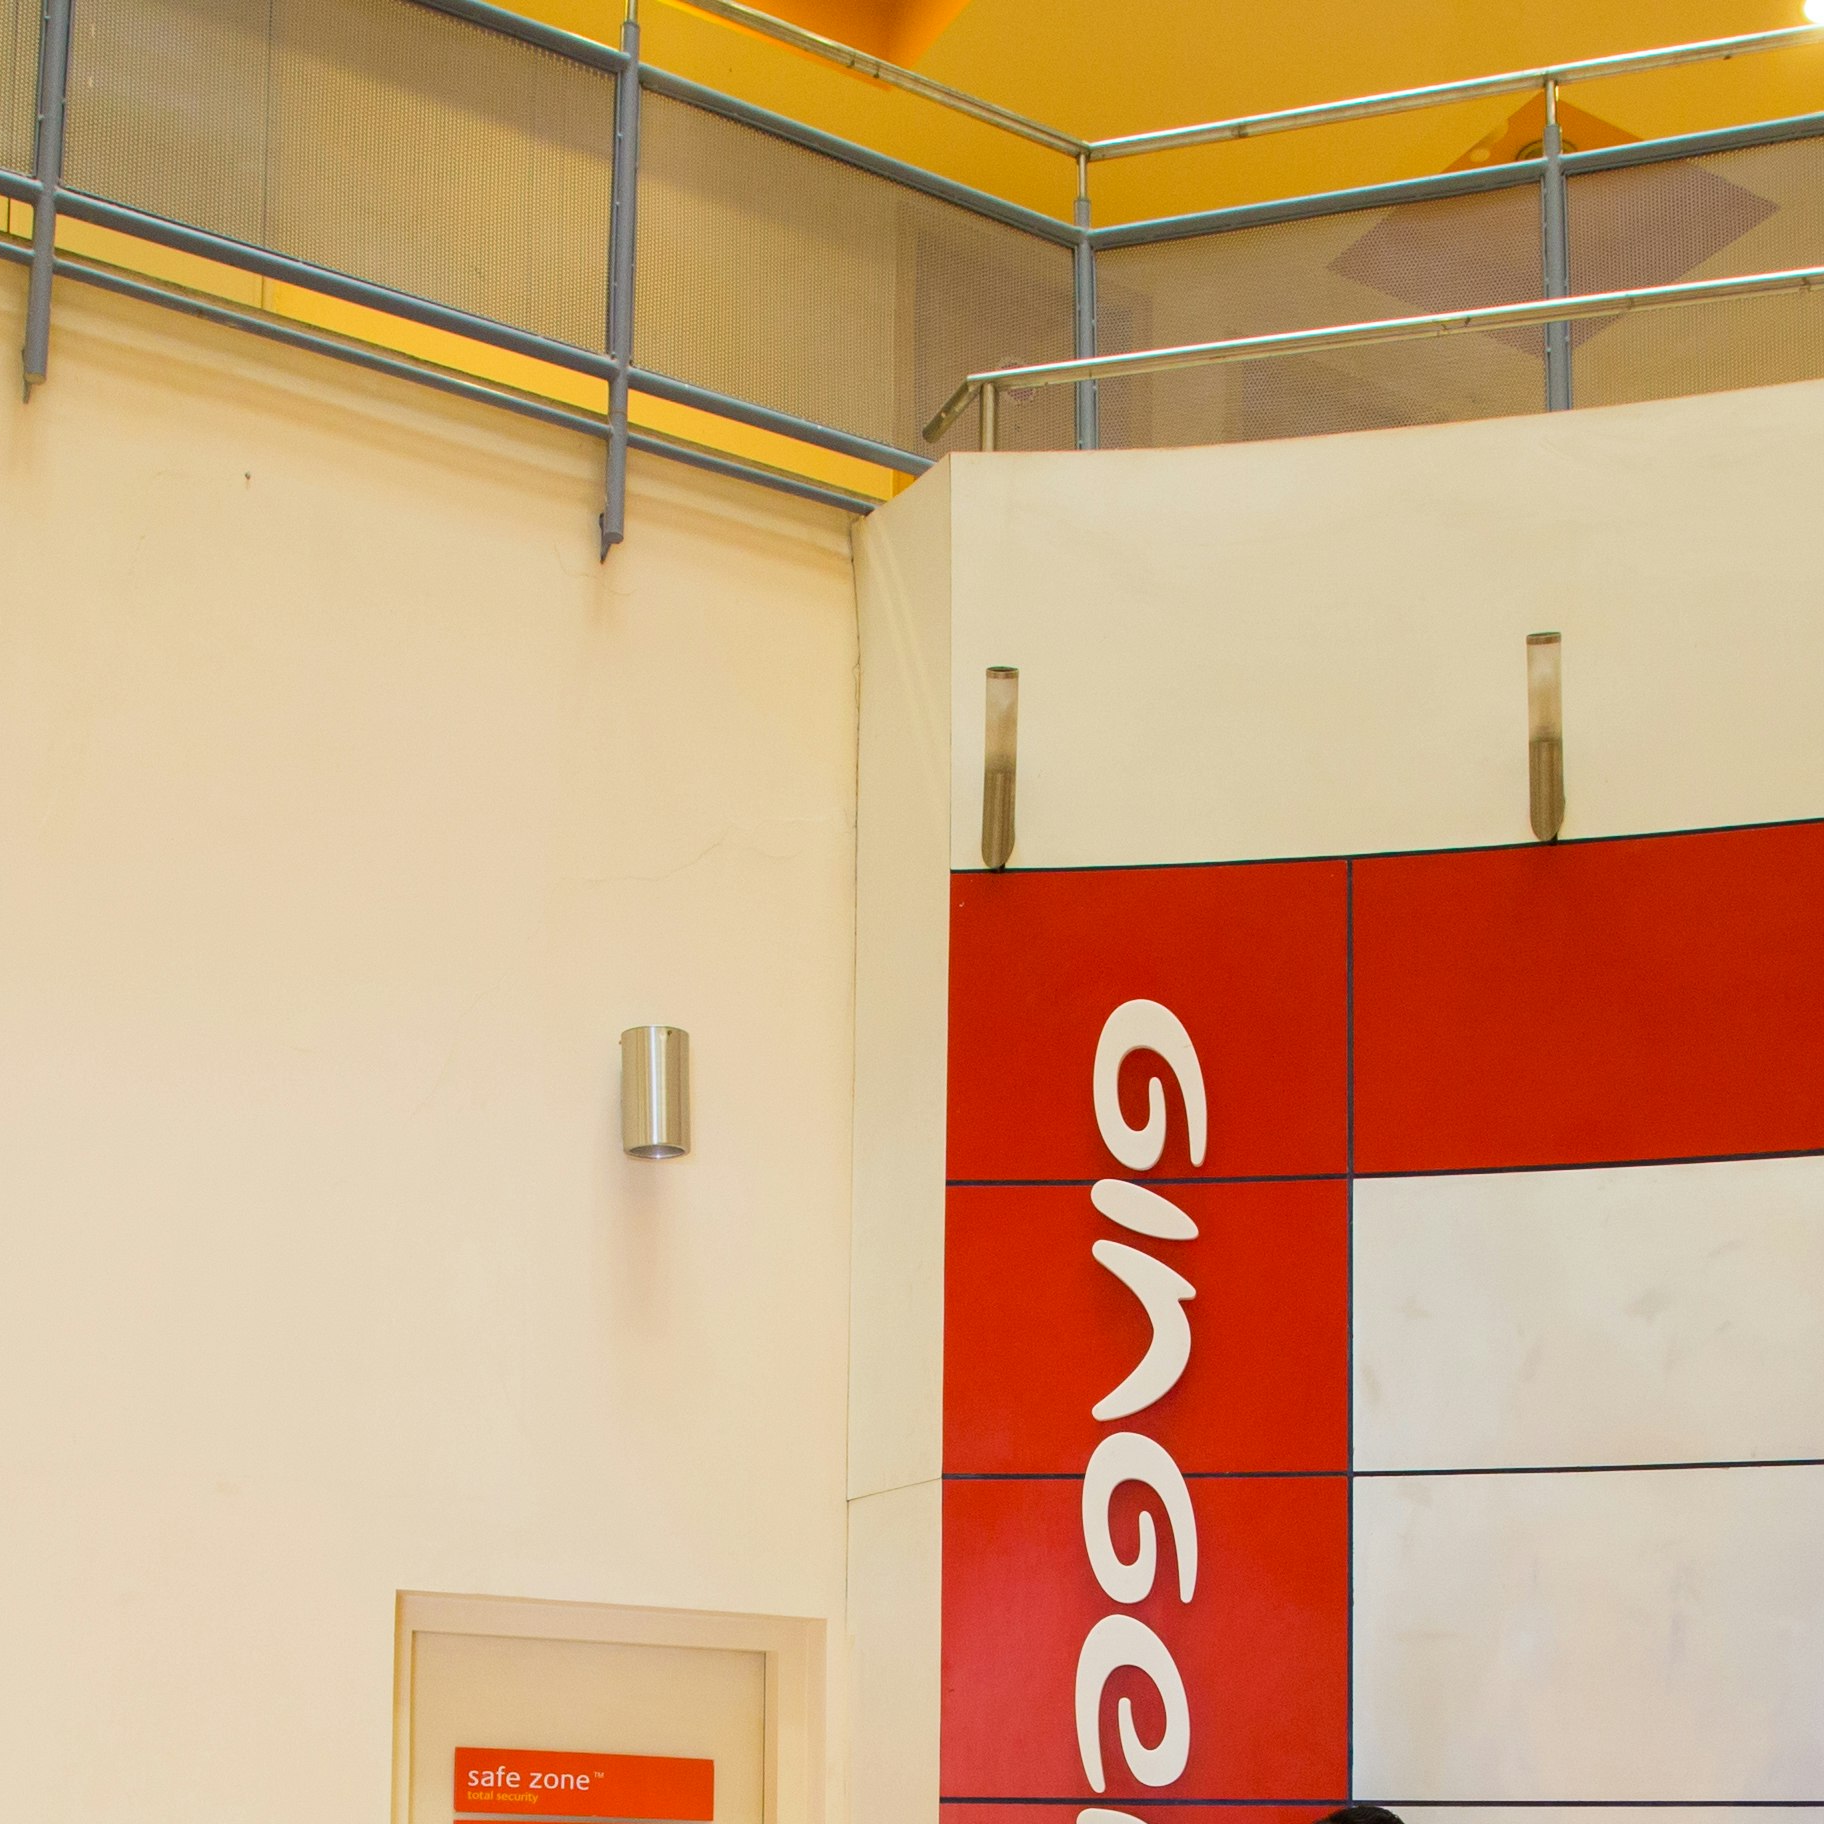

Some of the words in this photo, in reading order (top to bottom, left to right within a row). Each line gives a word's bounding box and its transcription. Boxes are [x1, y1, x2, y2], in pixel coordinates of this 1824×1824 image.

[467, 1765, 521, 1788] safe
[529, 1771, 590, 1791] zone
[467, 1790, 494, 1800] total
[496, 1791, 538, 1804] security
